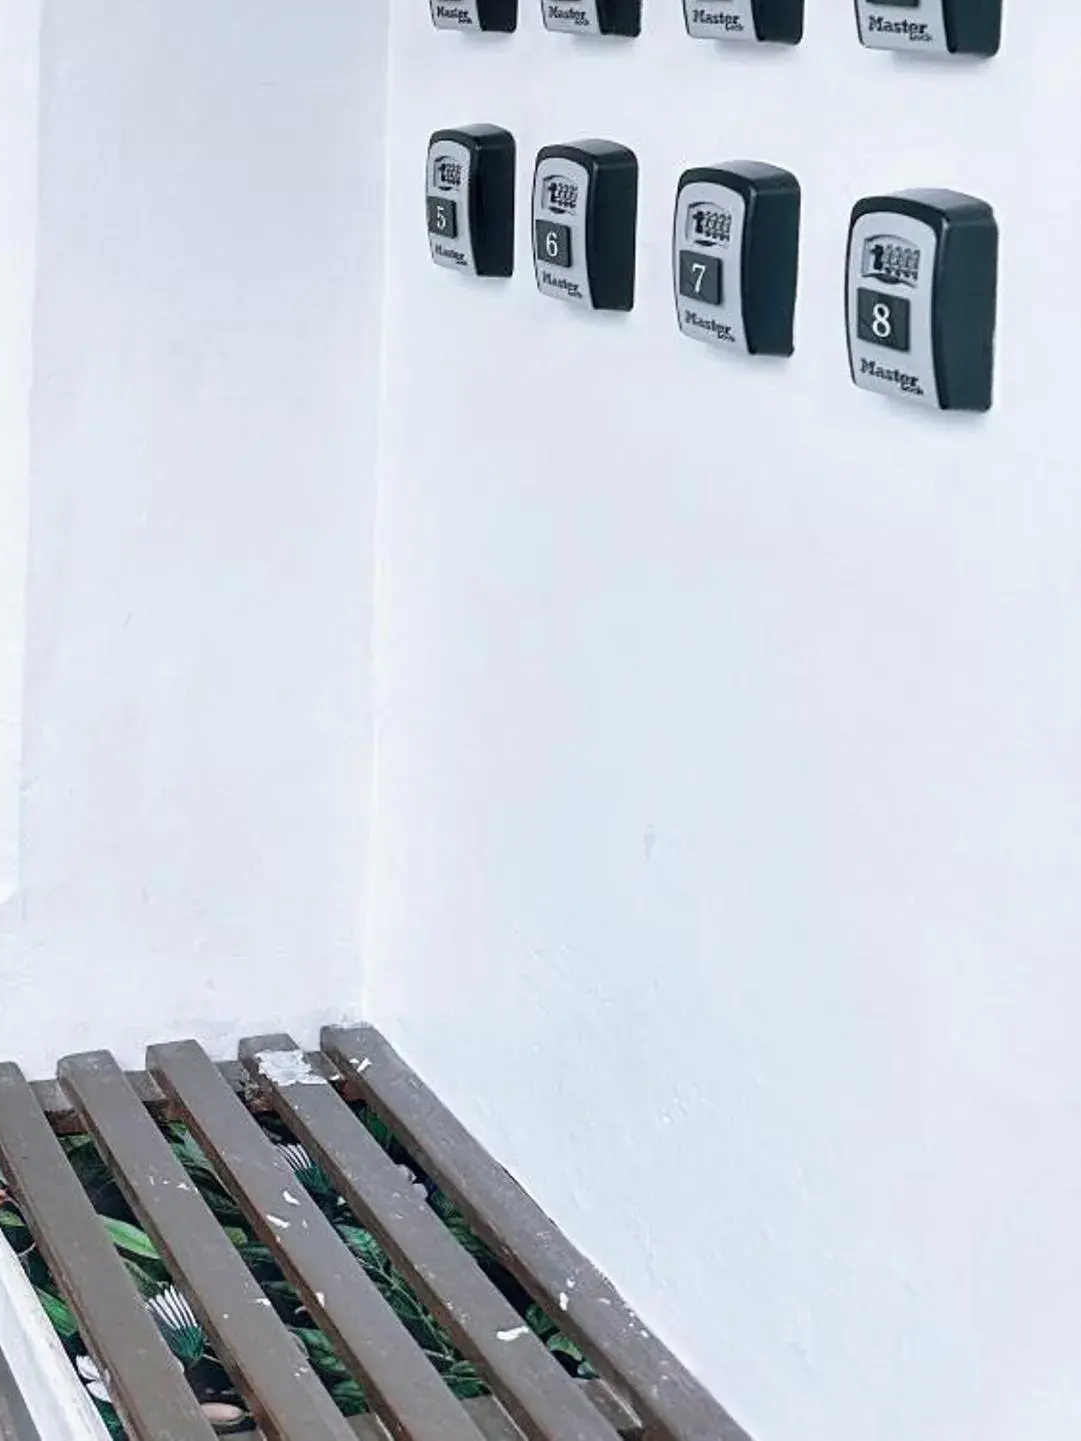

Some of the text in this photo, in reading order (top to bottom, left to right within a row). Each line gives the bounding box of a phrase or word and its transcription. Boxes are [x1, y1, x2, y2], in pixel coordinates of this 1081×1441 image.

[692, 8, 740, 24] Master
[868, 14, 928, 34] Master
[436, 206, 447, 230] 5
[546, 231, 558, 257] 6
[692, 263, 707, 293] 7
[685, 310, 732, 334] Master
[871, 303, 892, 338] 8
[859, 357, 920, 387] Master
